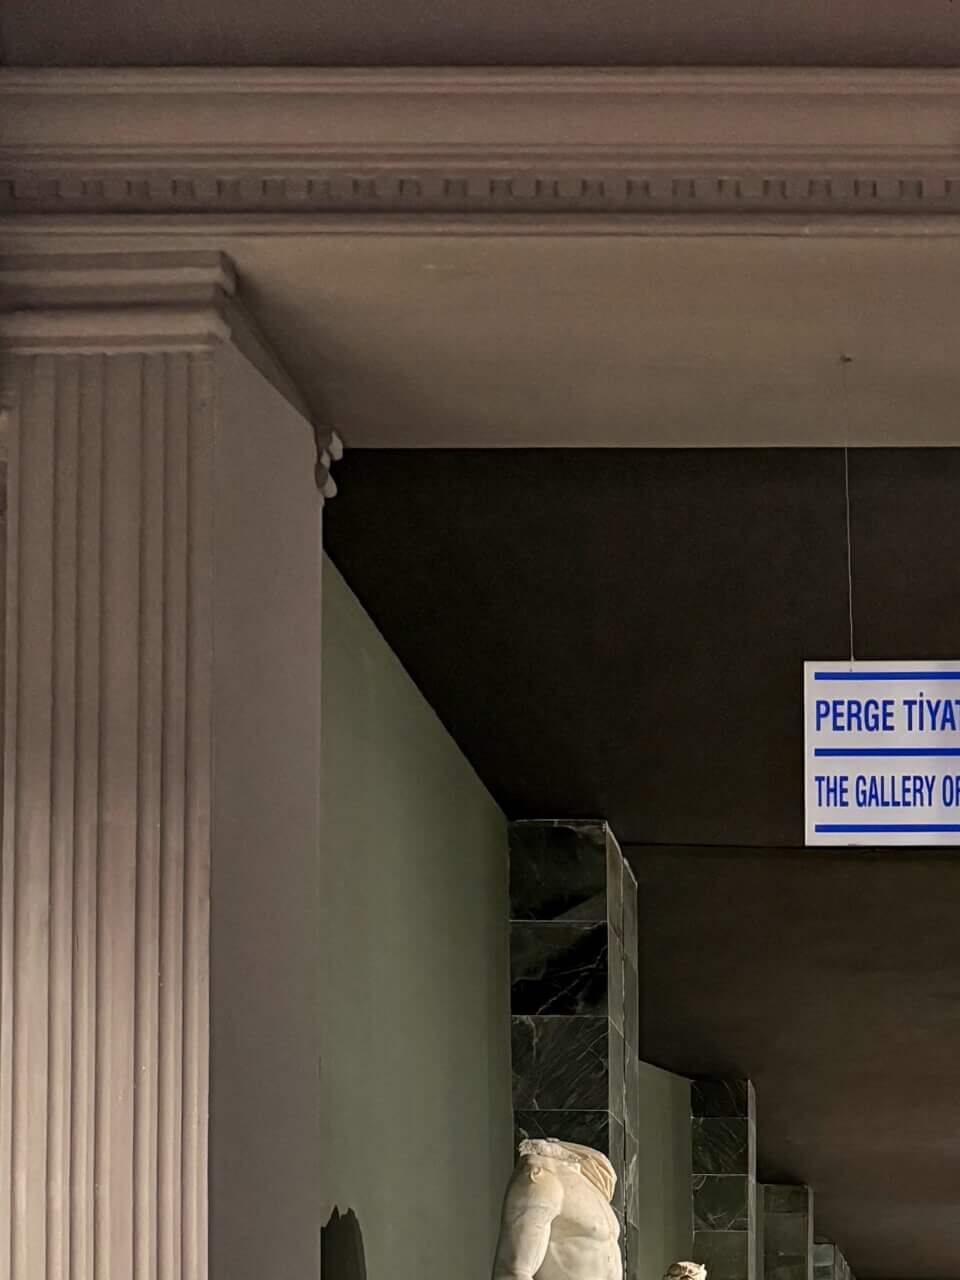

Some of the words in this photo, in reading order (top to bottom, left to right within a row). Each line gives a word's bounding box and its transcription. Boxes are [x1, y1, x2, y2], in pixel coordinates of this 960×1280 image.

[815, 698, 895, 732] PERGE
[814, 775, 849, 808] THE
[855, 775, 936, 808] GALLERY
